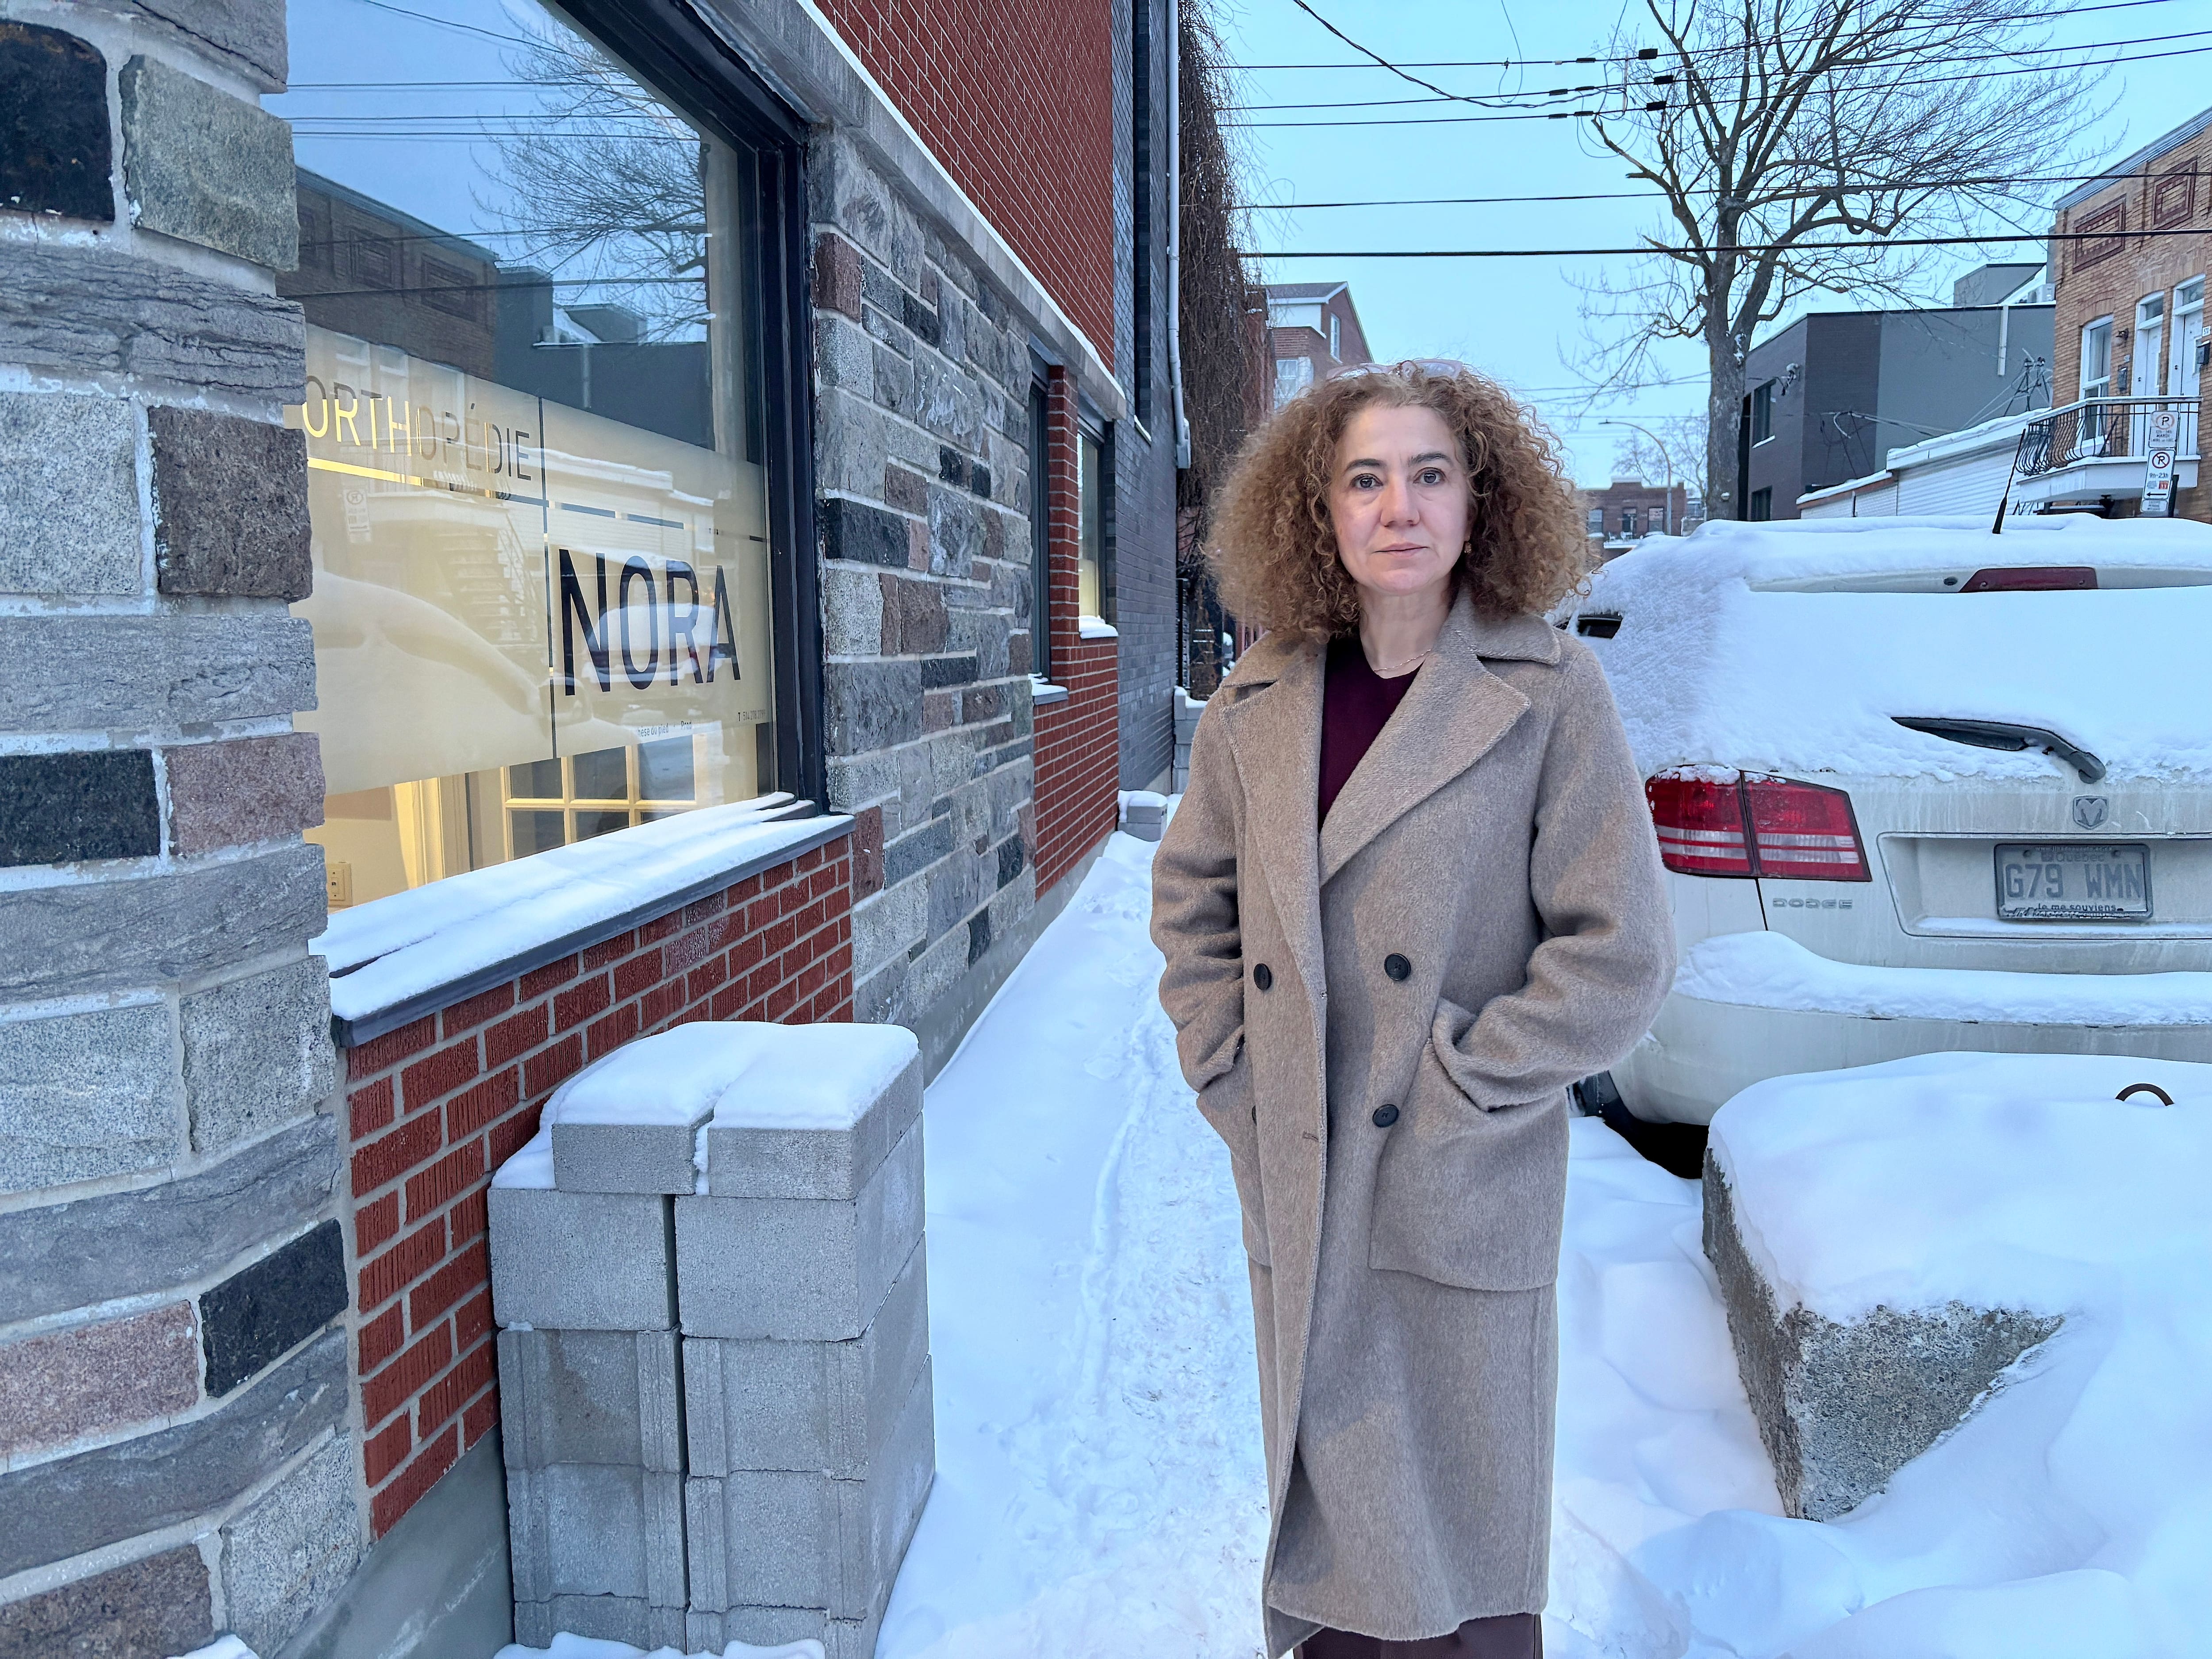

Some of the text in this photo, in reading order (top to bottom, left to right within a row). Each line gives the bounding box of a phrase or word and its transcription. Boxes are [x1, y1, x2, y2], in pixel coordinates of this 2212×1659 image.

[302, 375, 532, 481] ORTHOPÉDIE
[559, 549, 741, 696] NORA
[2005, 864, 2143, 899] G79 WMN
[1773, 898, 1853, 909] DODGE
[2070, 902, 2116, 911] souviens
